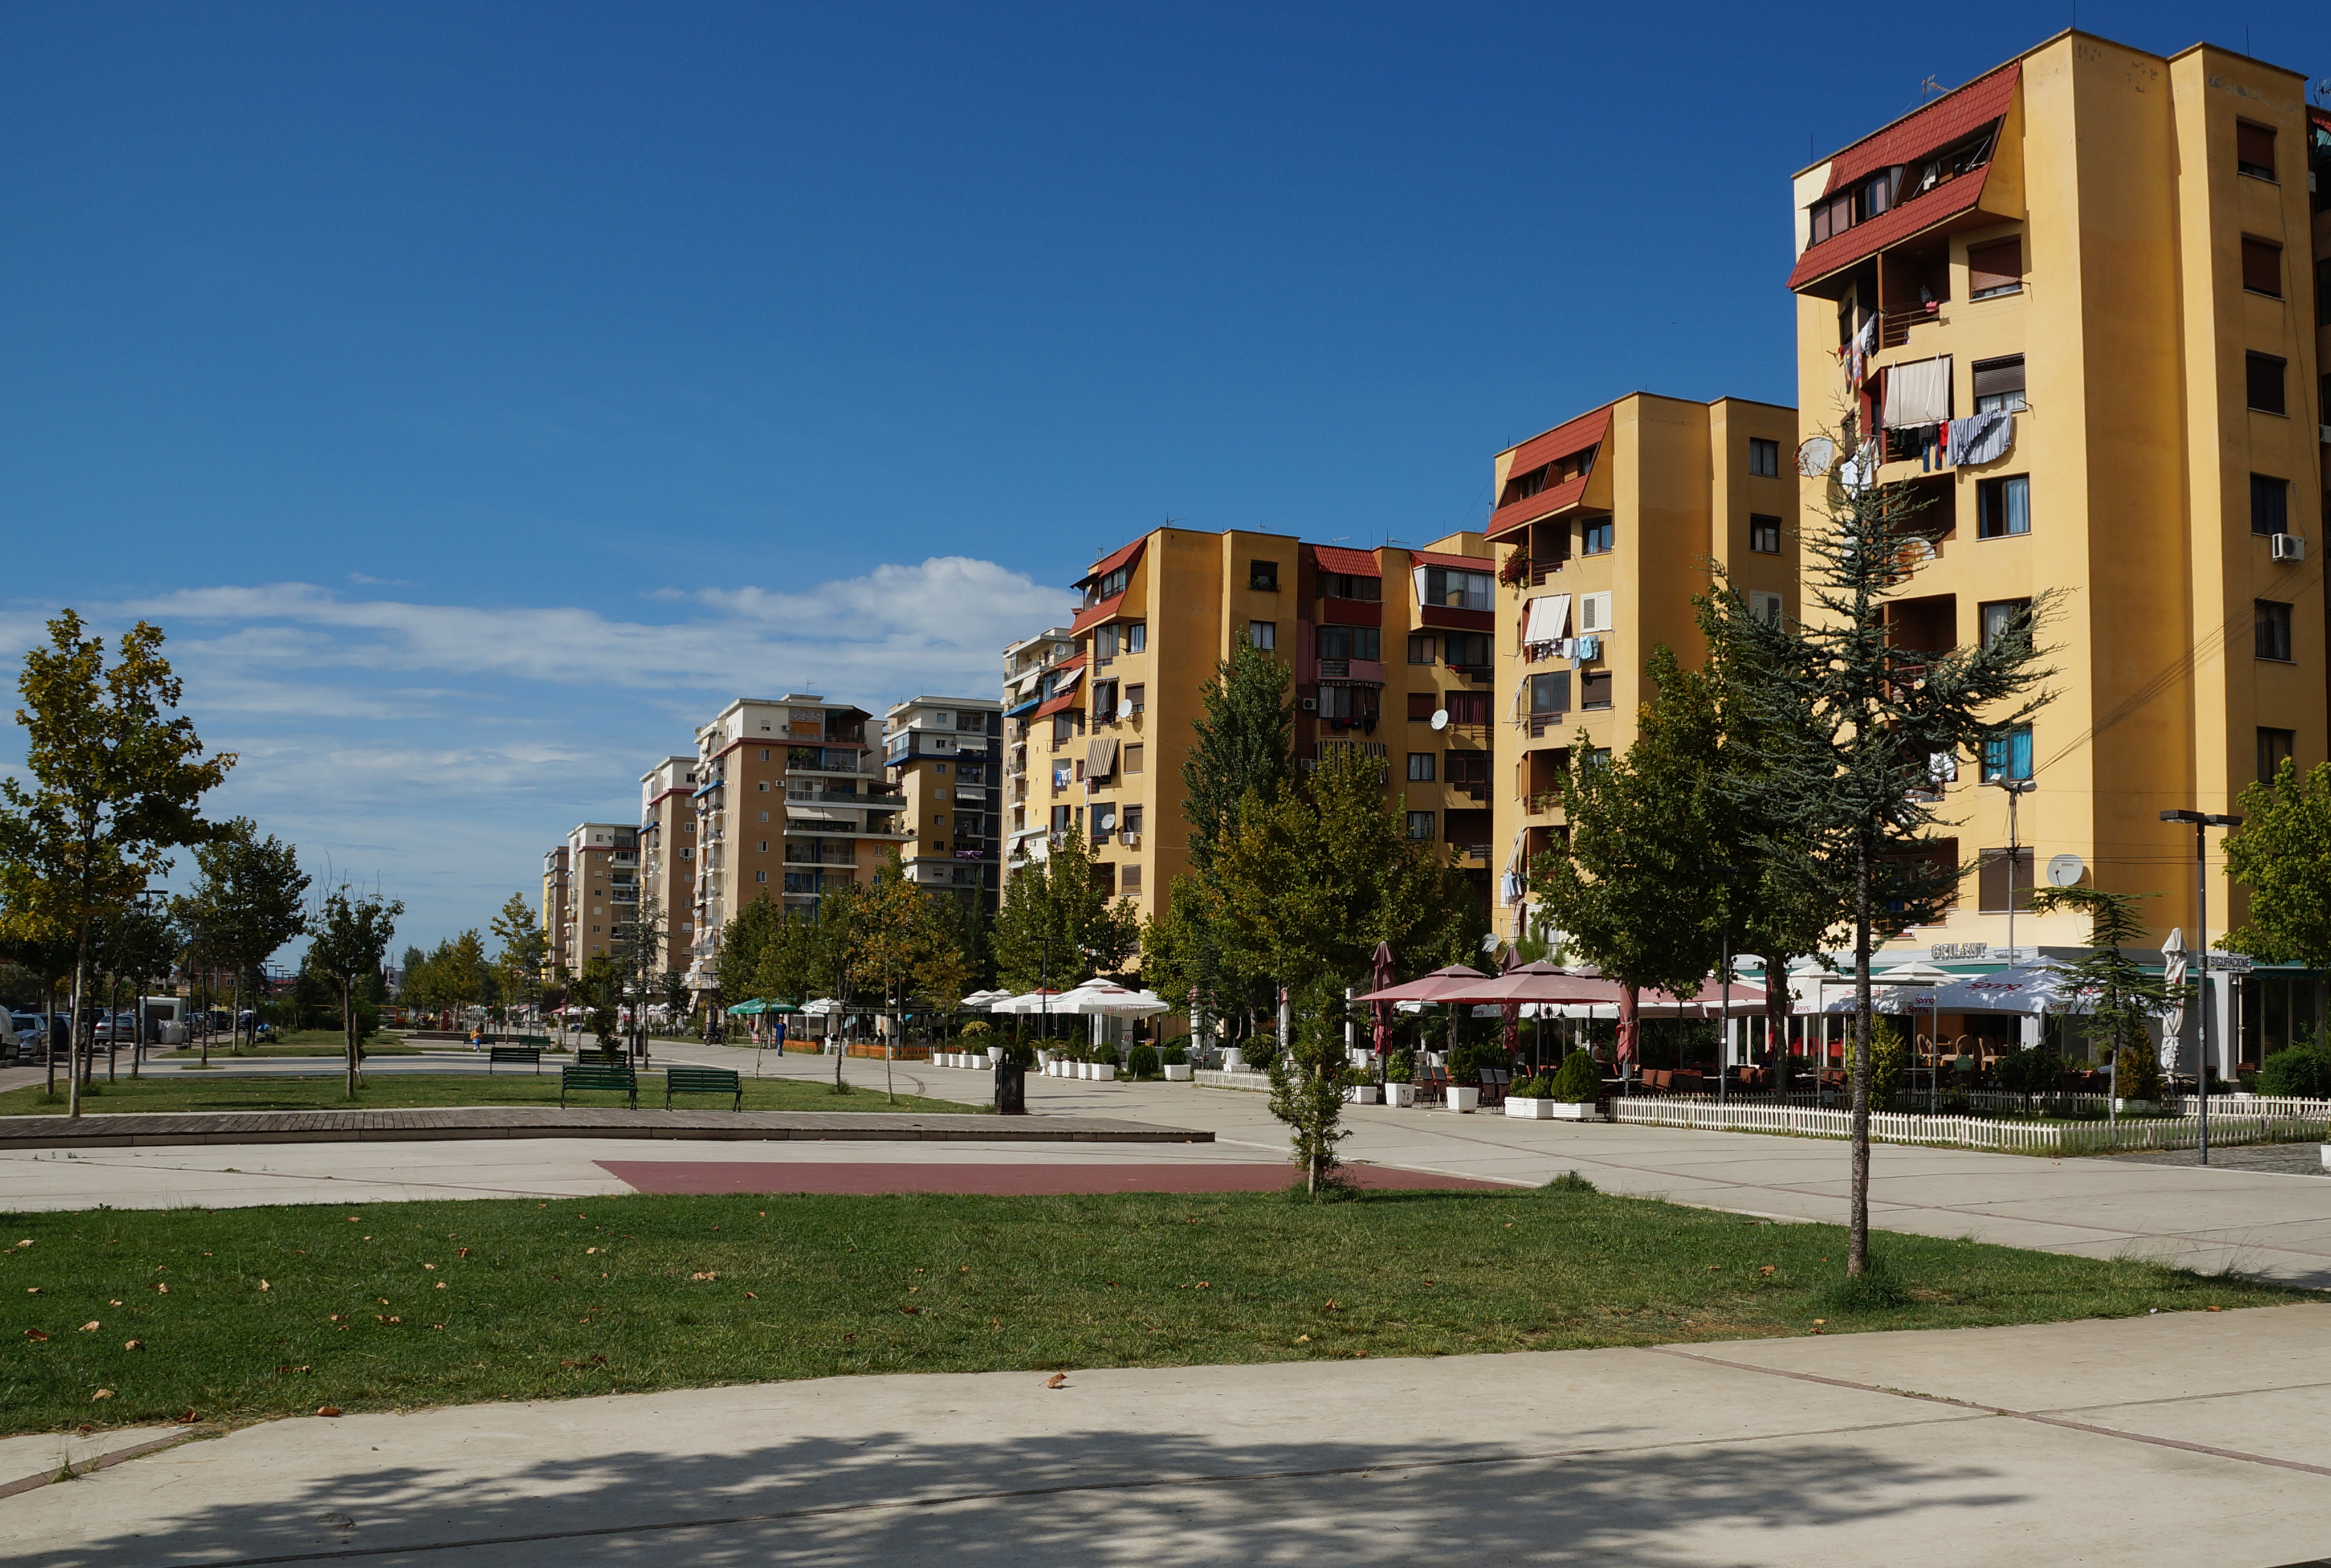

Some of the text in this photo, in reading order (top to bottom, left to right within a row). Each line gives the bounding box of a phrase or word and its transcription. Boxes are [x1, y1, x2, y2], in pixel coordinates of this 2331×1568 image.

[1931, 942, 1987, 958] BRILANT
[2211, 957, 2250, 967] SIGURACIONE
[1965, 982, 2023, 991] Spring
